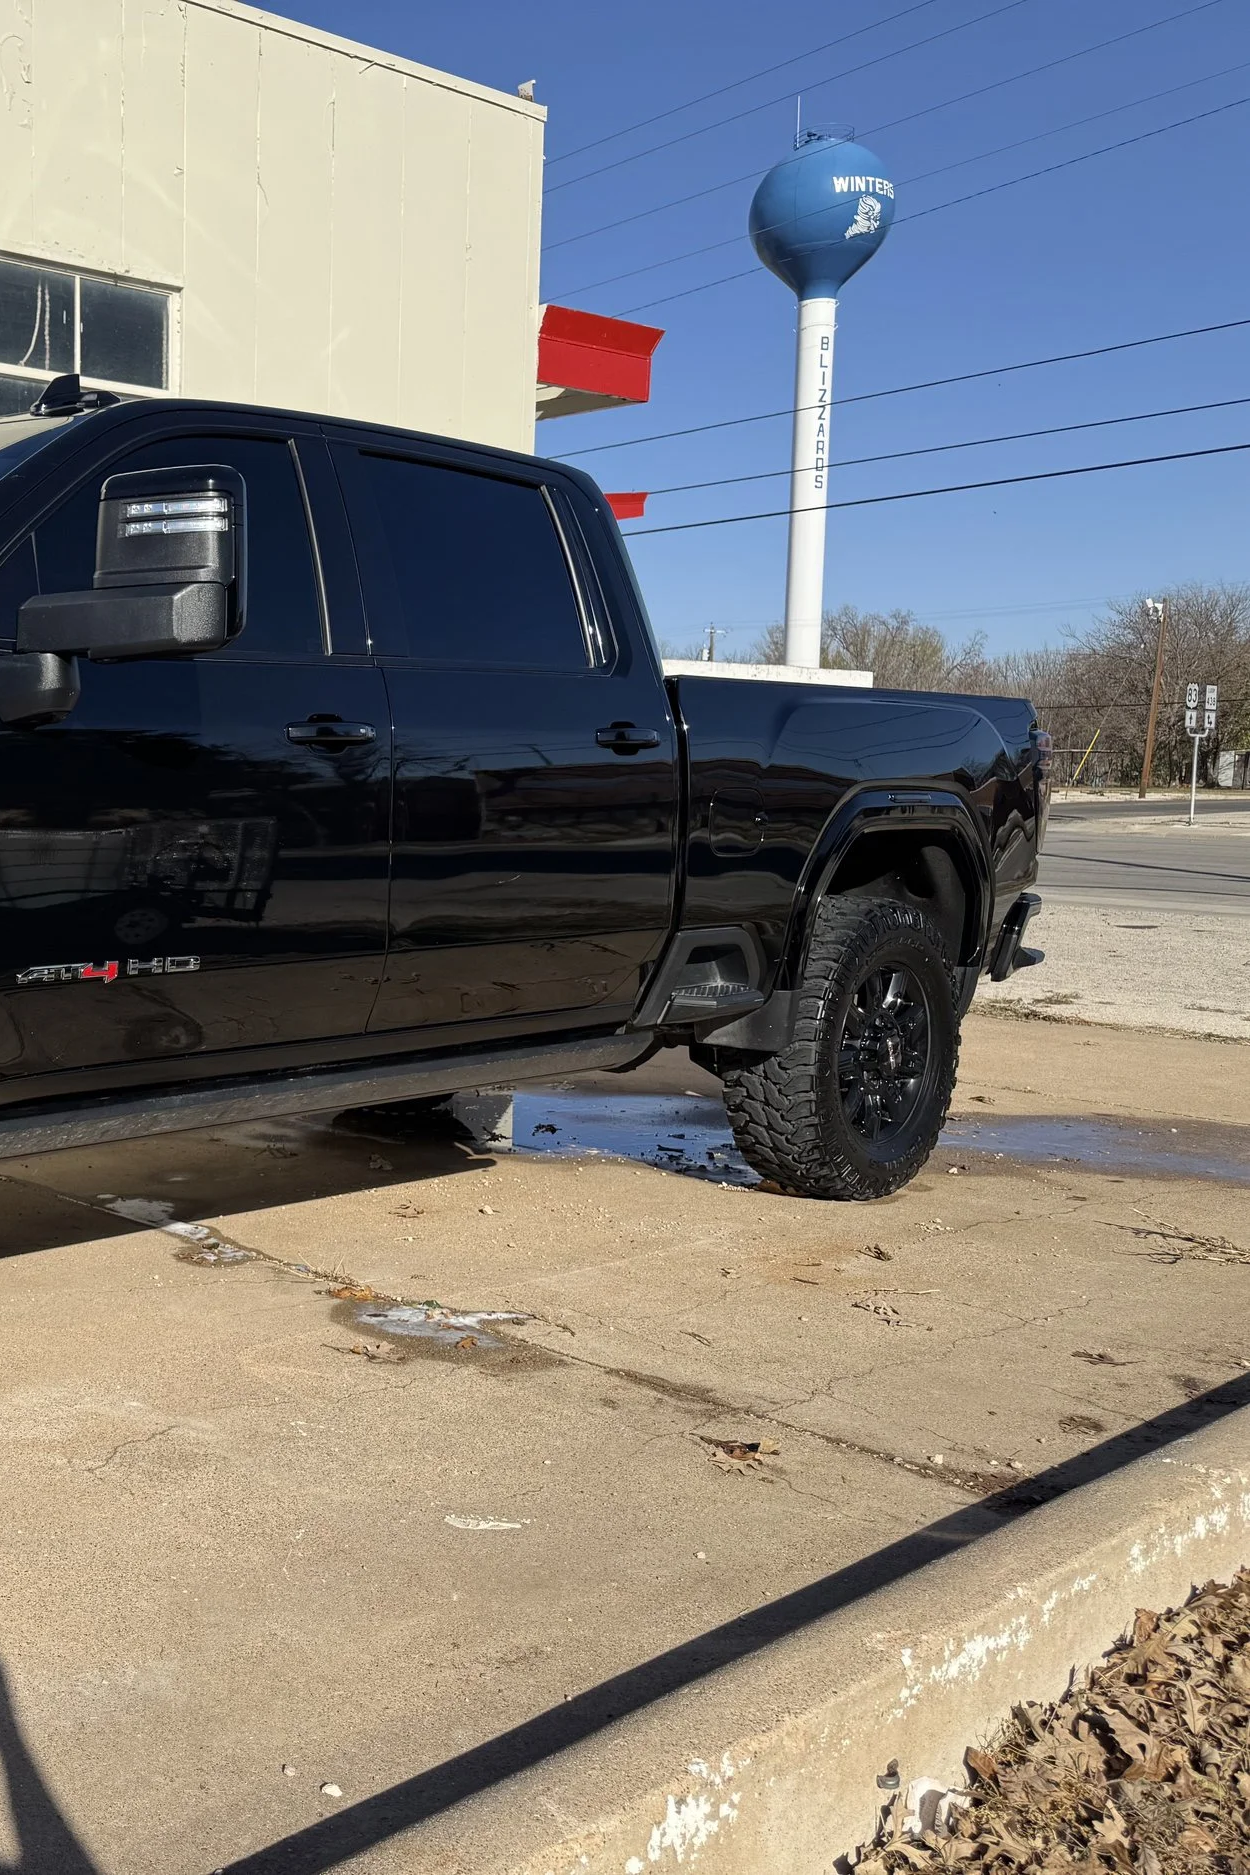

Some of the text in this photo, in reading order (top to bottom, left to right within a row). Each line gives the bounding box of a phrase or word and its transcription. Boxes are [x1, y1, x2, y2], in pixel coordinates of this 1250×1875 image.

[833, 176, 894, 199] WINTERS
[815, 336, 830, 489] BLIZZARDS
[1187, 688, 1198, 703] 83
[16, 955, 201, 984] AT4 HD
